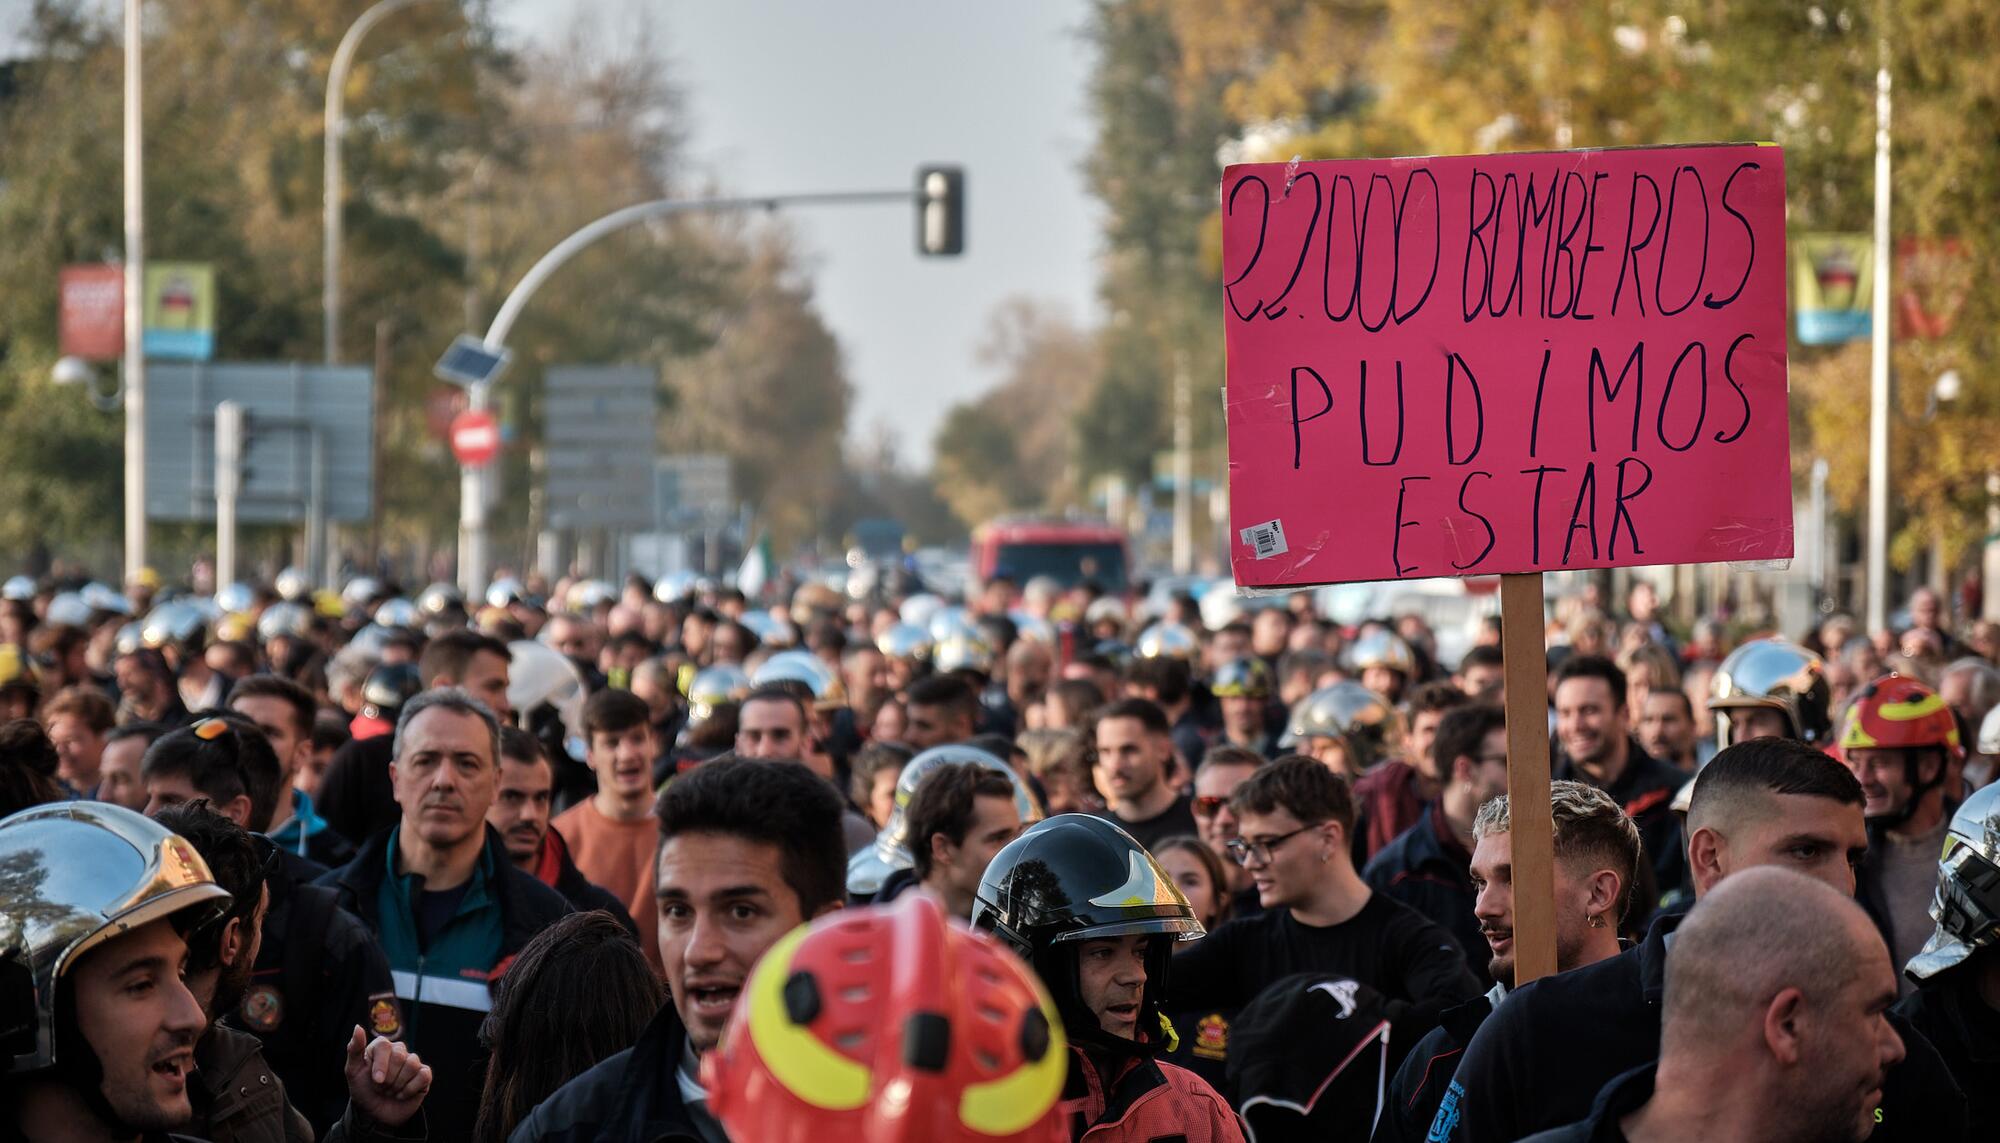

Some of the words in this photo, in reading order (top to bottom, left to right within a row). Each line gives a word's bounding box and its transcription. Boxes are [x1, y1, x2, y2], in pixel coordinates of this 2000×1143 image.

[1225, 168, 1440, 333] 22.000
[1463, 163, 1761, 322] BOMBEROS
[1291, 334, 1755, 470] PUDIMOS
[1393, 458, 1652, 577] ESTAR
